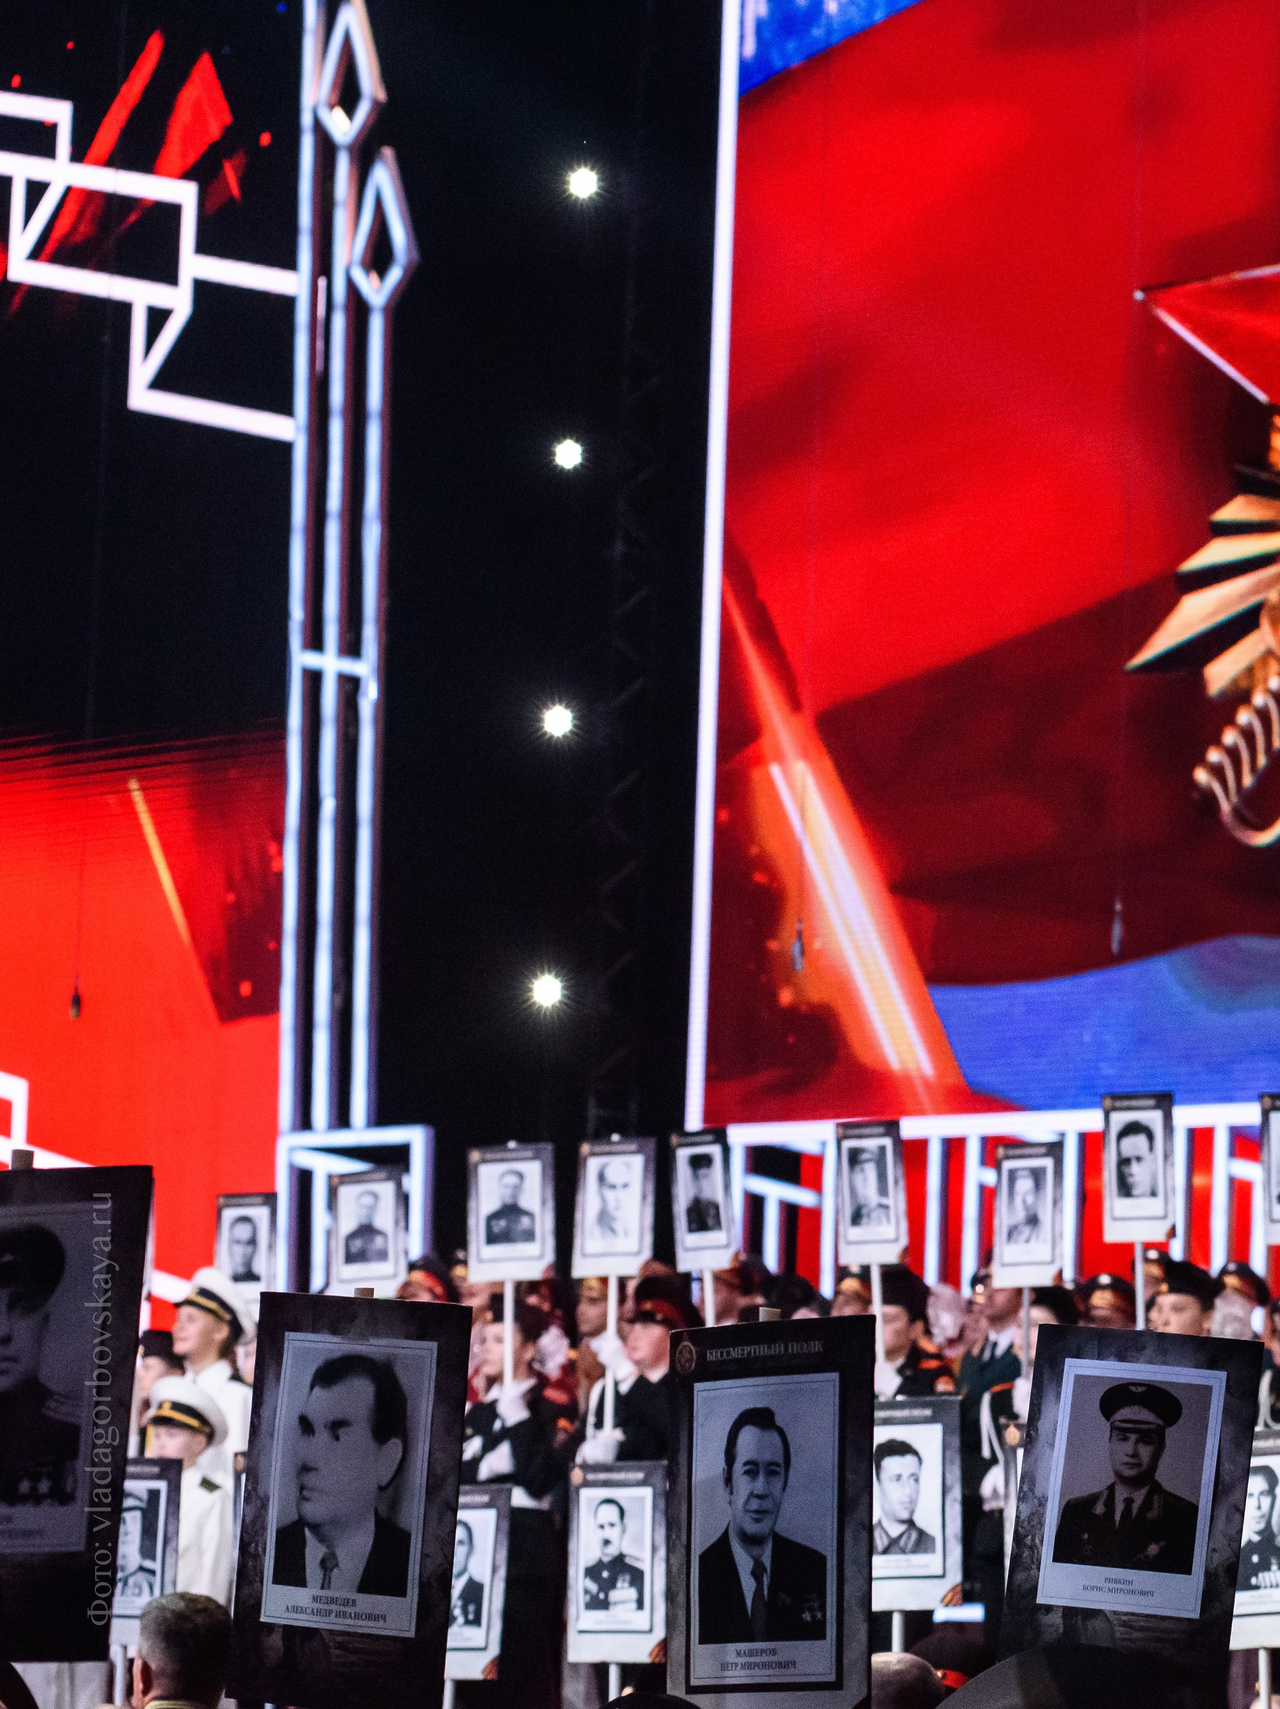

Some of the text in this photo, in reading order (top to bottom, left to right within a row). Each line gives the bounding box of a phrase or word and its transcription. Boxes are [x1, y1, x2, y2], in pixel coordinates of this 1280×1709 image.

[707, 1340, 824, 1361] БЕССМЕРТНЫЙ ПОЛК
[1082, 1584, 1155, 1597] БОРИС МИРОНОВИЧ
[311, 1594, 357, 1608] МЕДВЕДЕВ
[284, 1604, 387, 1623] АЛЕКСАНДР ИВАНОВИЧ
[735, 1648, 778, 1658] МАШЕРОВ
[740, 1660, 797, 1671] МИРОНОВИЧ
